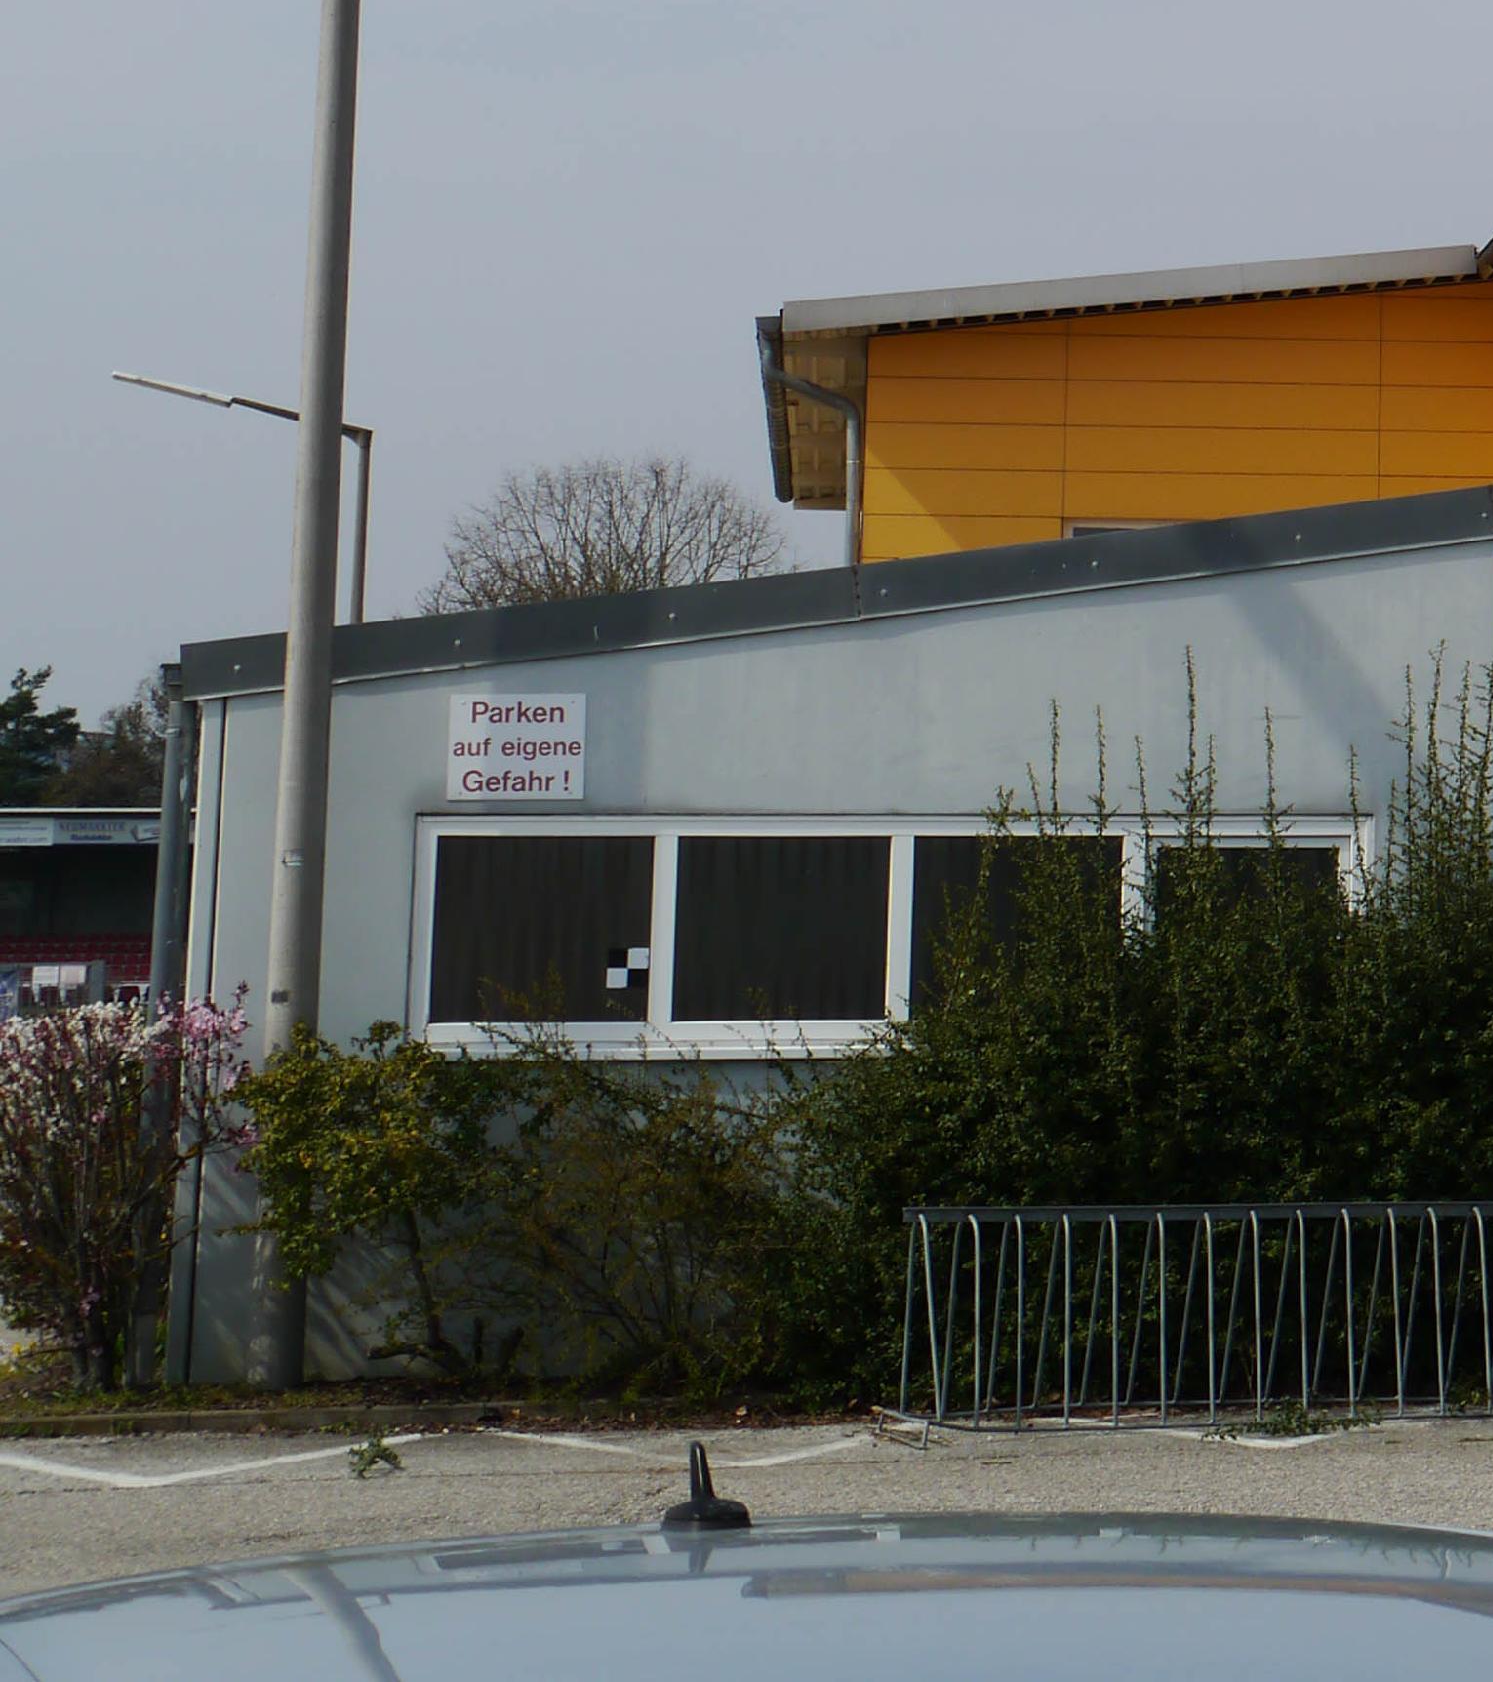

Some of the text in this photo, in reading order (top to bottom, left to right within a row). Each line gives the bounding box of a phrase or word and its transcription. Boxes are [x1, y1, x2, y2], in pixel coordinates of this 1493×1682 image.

[471, 700, 565, 724] Parken
[453, 737, 582, 761] auf eigene
[462, 769, 555, 793] Gefahr
